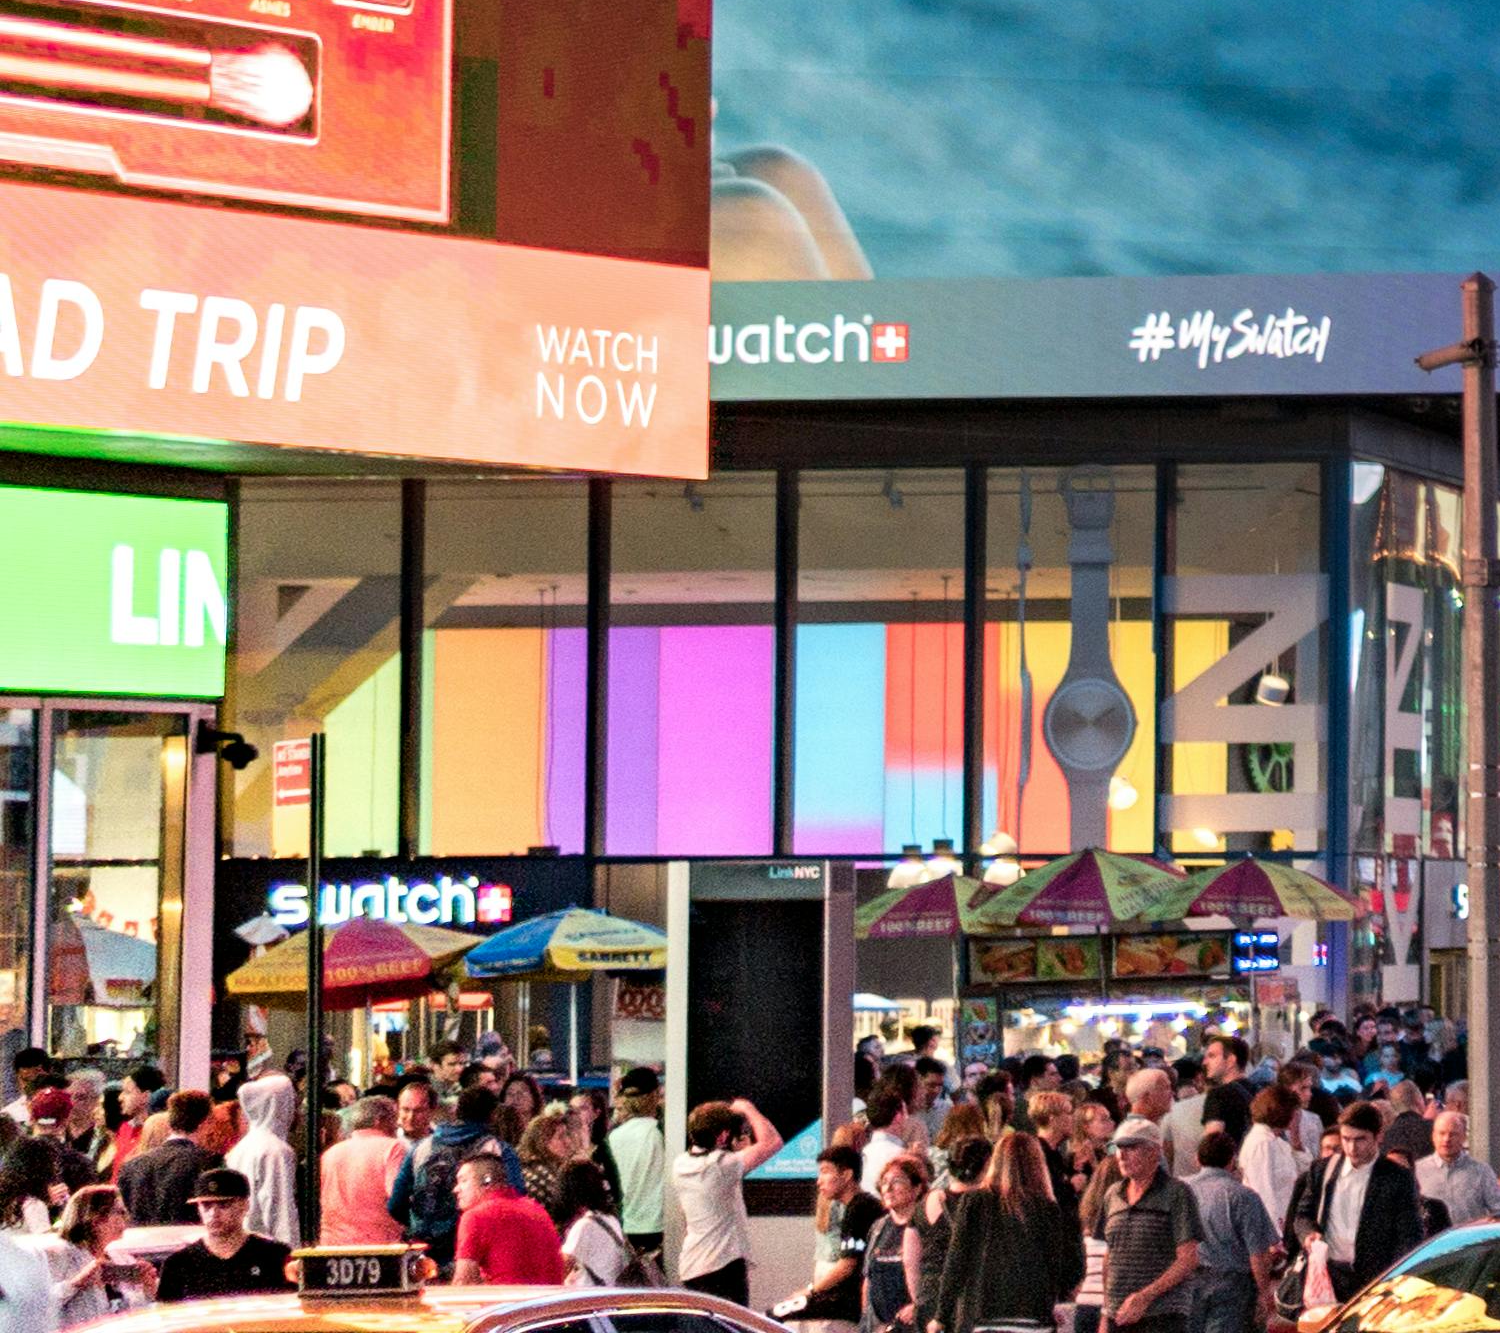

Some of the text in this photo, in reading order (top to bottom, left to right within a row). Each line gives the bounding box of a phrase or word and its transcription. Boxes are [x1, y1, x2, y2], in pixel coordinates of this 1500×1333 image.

[139, 288, 346, 403] TRIP
[536, 323, 660, 376] WATCH
[536, 375, 658, 429] NOW
[768, 865, 821, 880] LinkNYC
[270, 876, 477, 926] swatch
[325, 1257, 381, 1286] 3D79
